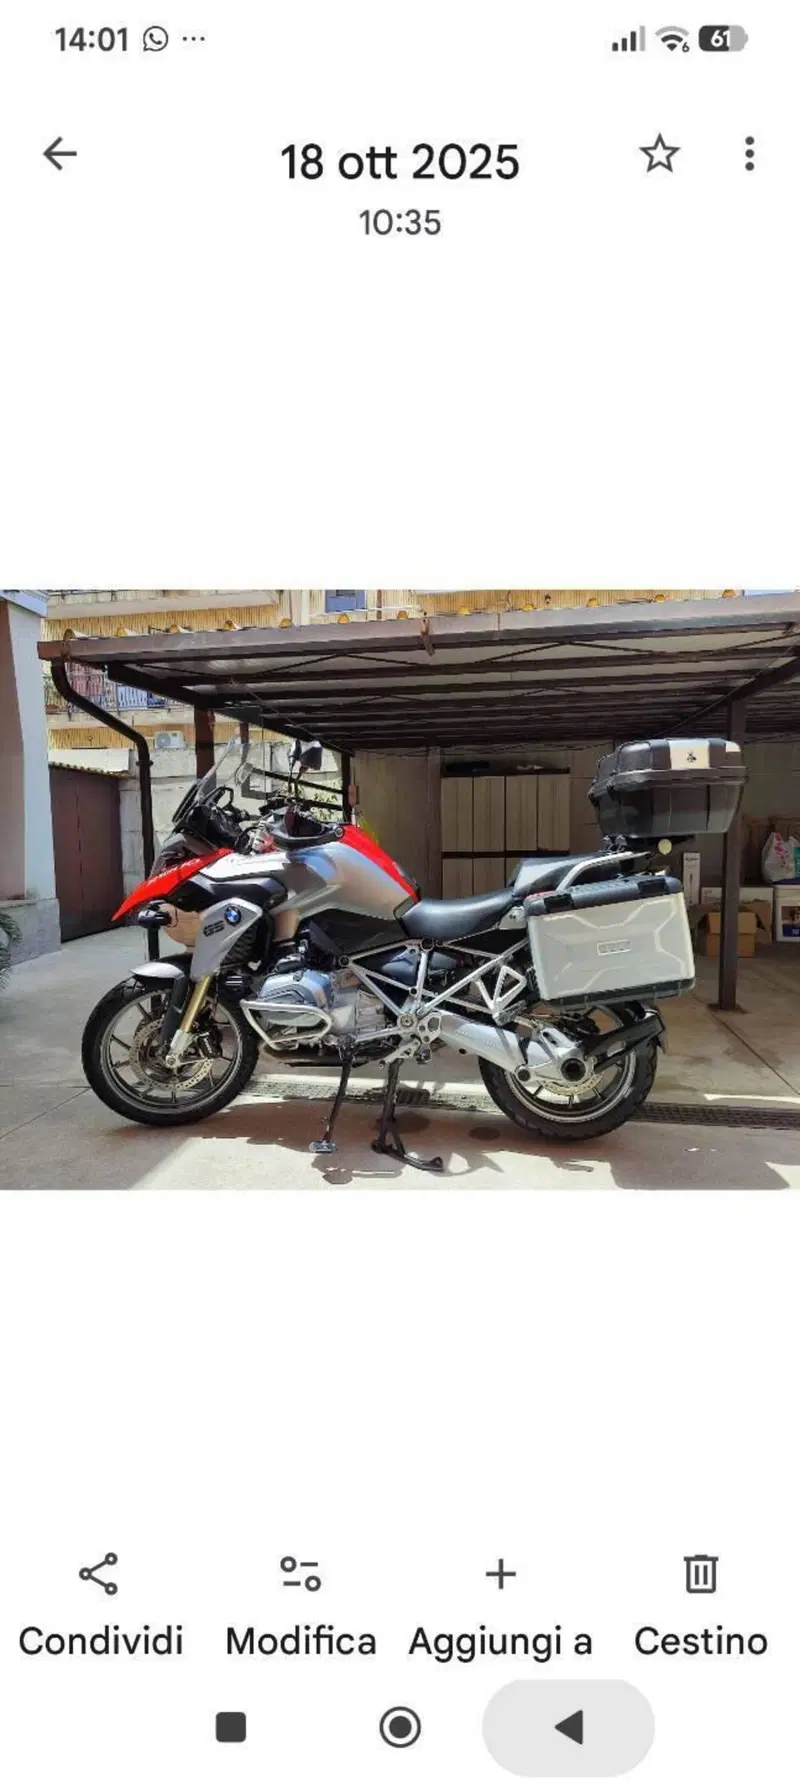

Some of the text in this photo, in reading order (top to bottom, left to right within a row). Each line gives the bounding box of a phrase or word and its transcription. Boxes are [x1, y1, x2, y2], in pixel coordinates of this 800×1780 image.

[55, 26, 127, 52] 14:01
[681, 41, 690, 53] 6
[711, 29, 730, 47] 61
[281, 143, 520, 180] 18 ott 2025
[359, 209, 441, 236] 10:35
[203, 920, 225, 937] GS
[18, 1625, 183, 1656] Condividi
[226, 1625, 376, 1656] Modifica
[408, 1625, 592, 1664] Aggiungi a
[634, 1625, 768, 1656] Cestino
